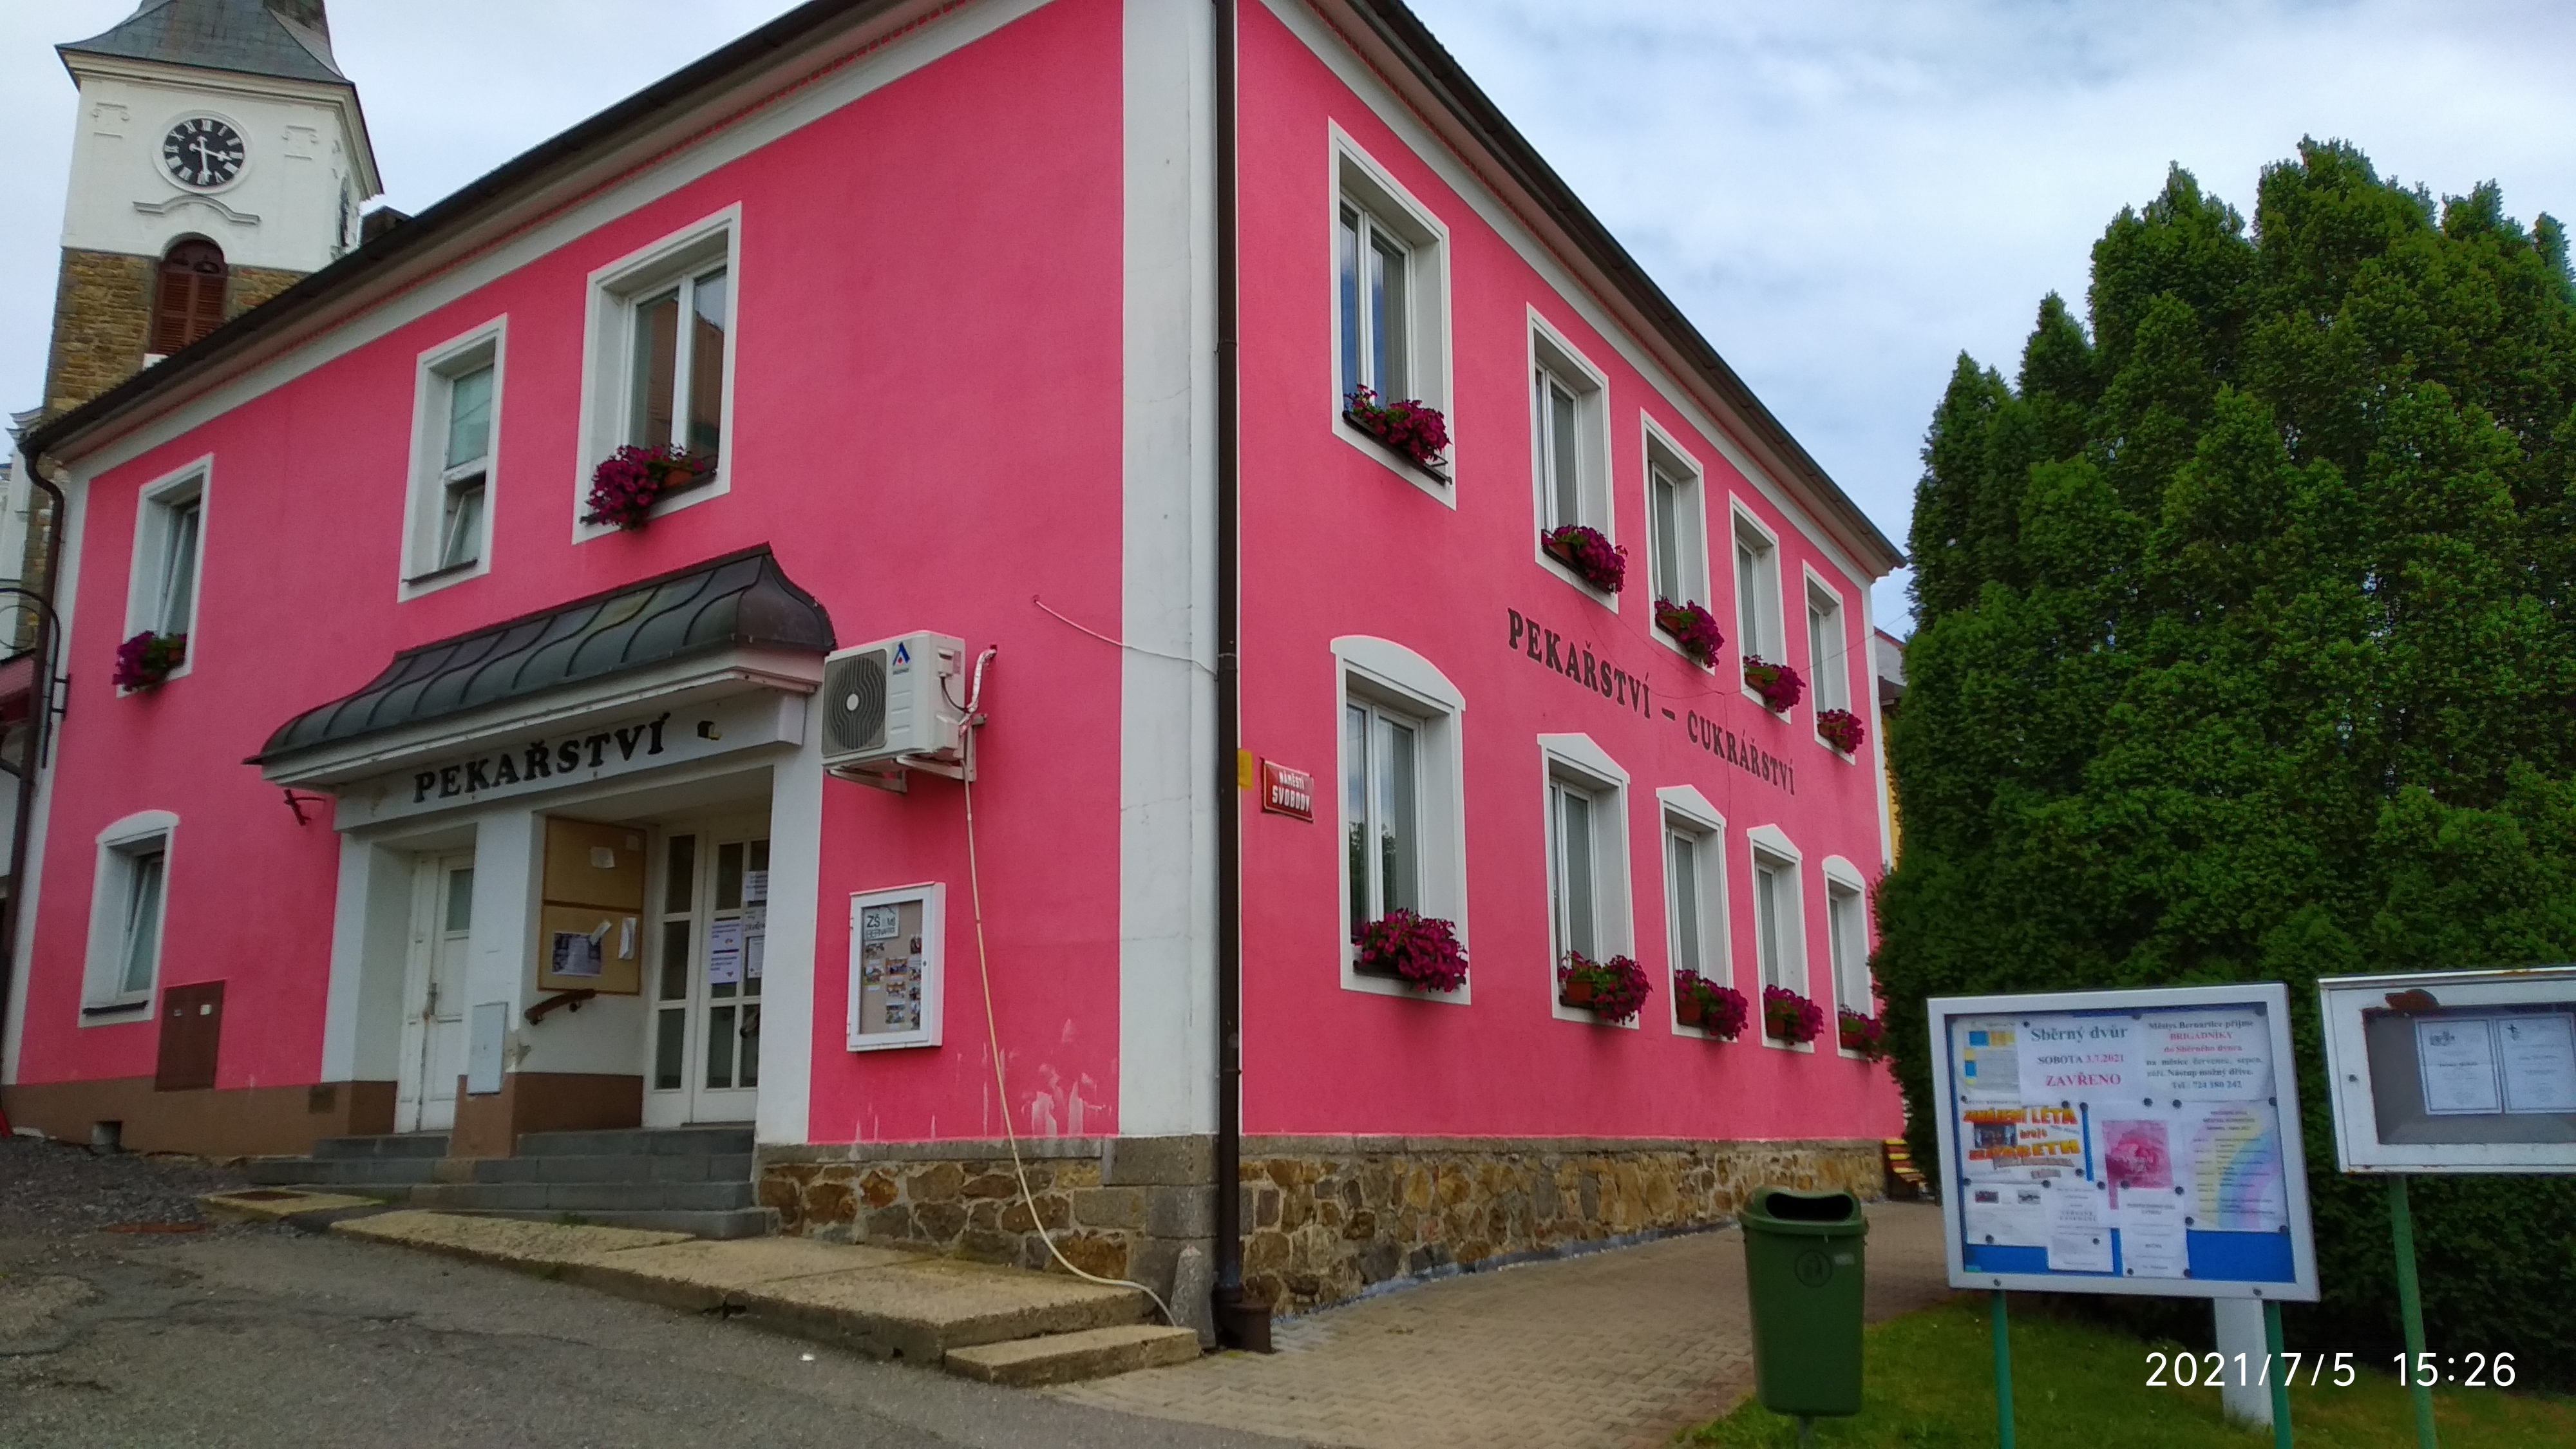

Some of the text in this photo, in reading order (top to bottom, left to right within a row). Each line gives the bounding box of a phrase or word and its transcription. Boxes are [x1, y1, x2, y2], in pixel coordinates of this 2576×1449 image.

[1507, 607, 1651, 719] PEKAŘSTVÍ
[1687, 709, 1795, 796] CUKRÁŘSTVÍ
[412, 712, 672, 803] PEKAŘSTVÍ
[1278, 769, 1305, 791] NÁMĚSTÍ
[1271, 784, 1311, 813] SVOBODY
[2031, 1025, 2128, 1043] Sběrný dvůr
[2148, 1019, 2254, 1030] Městys Bernartice přijme
[2036, 1054, 2125, 1065] SOBOTA 3.7.2021
[2045, 1071, 2121, 1088] ZAVŘENO
[2168, 1068, 2197, 1077] Nástup
[2199, 1068, 2226, 1077] možný
[2031, 1105, 2078, 1125] LÉTA
